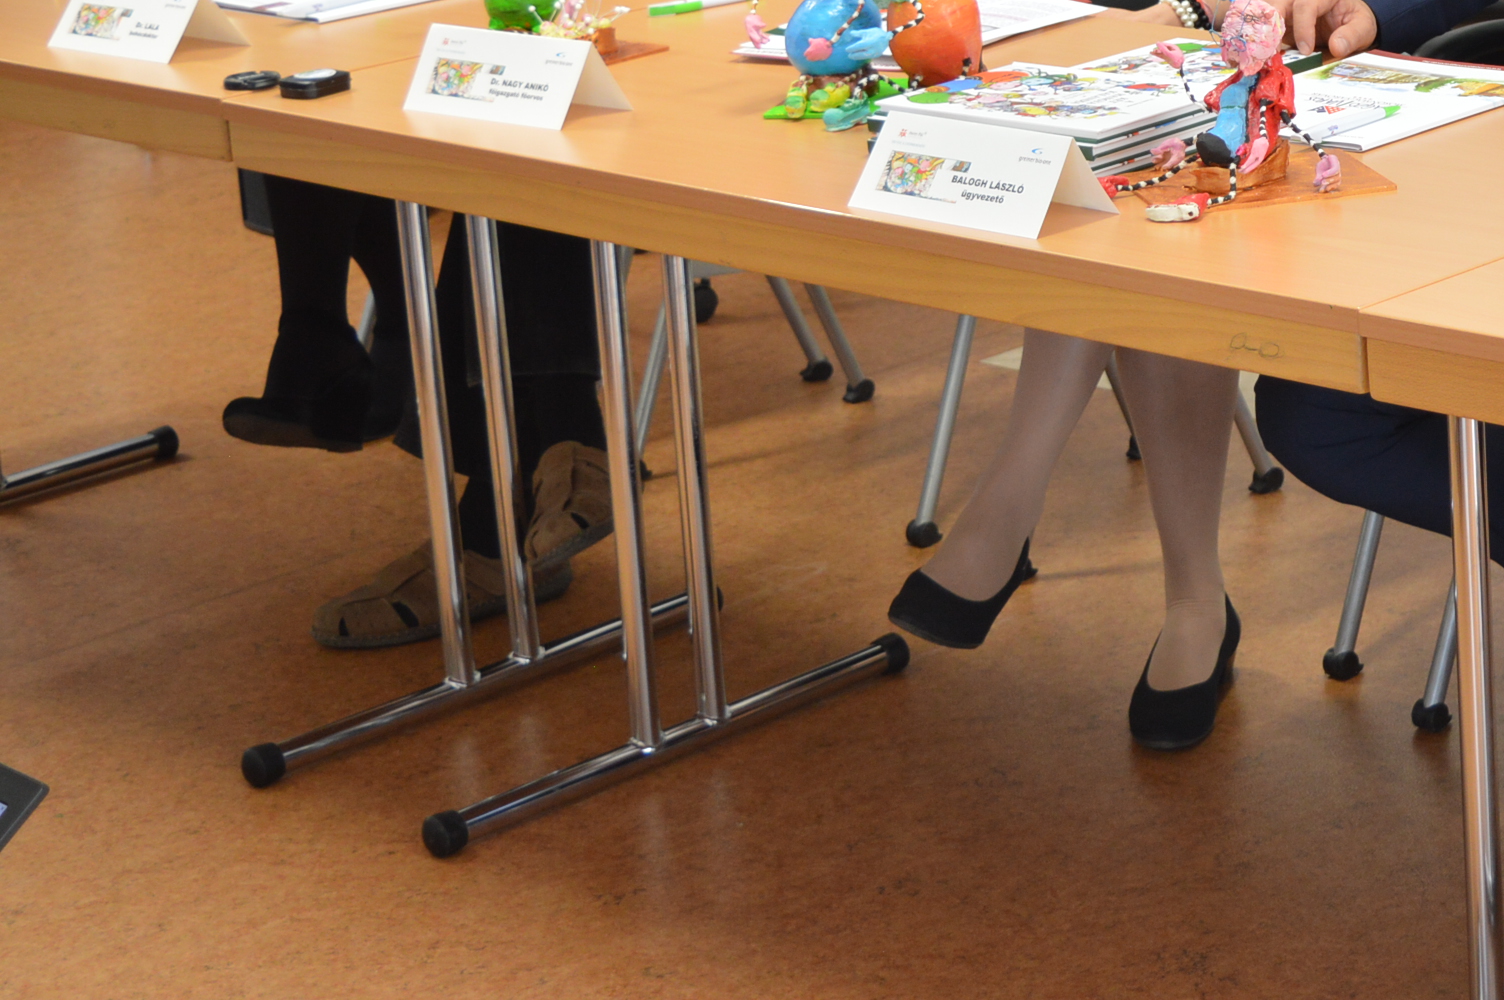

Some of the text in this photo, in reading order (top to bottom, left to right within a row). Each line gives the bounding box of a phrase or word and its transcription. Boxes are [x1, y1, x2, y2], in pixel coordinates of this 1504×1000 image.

[490, 77, 549, 92] Dr. NAGY ANIKÓ
[520, 91, 544, 102] főorvos
[951, 174, 1025, 194] BALOGH LÁSZLÓ
[961, 189, 1004, 204] ügyvezető
